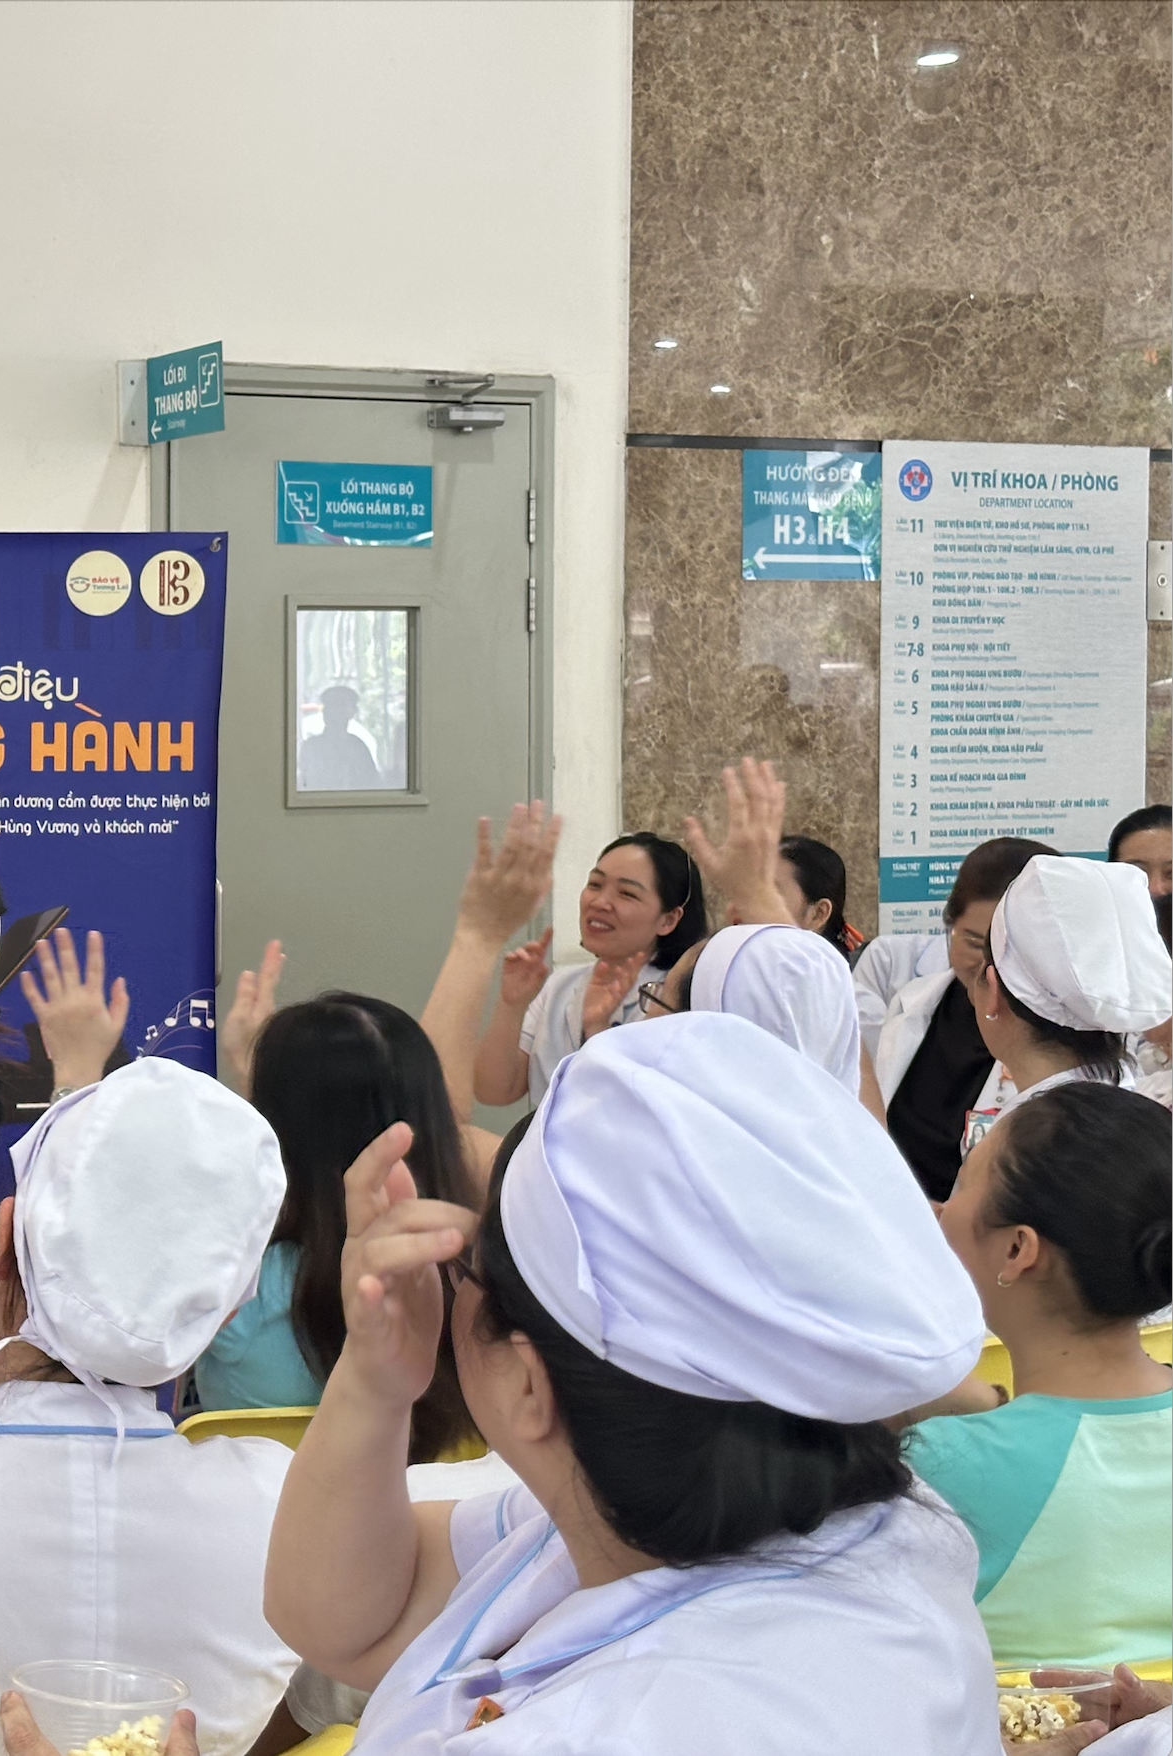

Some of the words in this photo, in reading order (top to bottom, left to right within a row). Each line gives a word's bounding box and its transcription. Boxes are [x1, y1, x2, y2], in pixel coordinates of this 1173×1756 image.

[163, 363, 177, 386] LỐI
[177, 365, 187, 383] ĐI
[154, 391, 184, 416] THANG
[185, 385, 198, 414] BỘ
[766, 462, 826, 482] HƯỚNG
[341, 478, 358, 494] LỐI
[360, 482, 397, 495] THANG
[398, 481, 414, 499] BỘ
[951, 471, 968, 493] VỊ
[971, 469, 998, 489] TRÍ
[1000, 472, 1048, 490] KHOA
[1060, 471, 1119, 492] PHÒNG
[753, 491, 790, 506] THANG
[979, 497, 1033, 509] DEPARTMENT
[1034, 498, 1074, 510] LOCATION
[325, 498, 364, 514] XUỐNG
[393, 503, 410, 517] B1,
[411, 503, 425, 516] B2
[774, 514, 807, 545] H3
[808, 534, 817, 546] &
[818, 515, 851, 546] H4
[910, 518, 924, 533] 11
[909, 571, 924, 586] 10
[912, 615, 920, 629] 9
[907, 642, 924, 657] 7-8
[912, 669, 919, 684] 6
[911, 701, 918, 715] 5
[30, 703, 195, 772] HÀNH
[910, 745, 918, 759] 4
[910, 774, 917, 788] 3
[13, 794, 54, 811] dương
[57, 790, 86, 808] cầm
[90, 794, 122, 811] được
[126, 794, 158, 811] thực
[161, 794, 189, 811] hiện
[193, 792, 210, 807] bởi
[910, 802, 917, 817] 2
[35, 819, 79, 836] Vương
[84, 818, 101, 834] và
[105, 818, 144, 834] khách
[911, 831, 917, 845] 1
